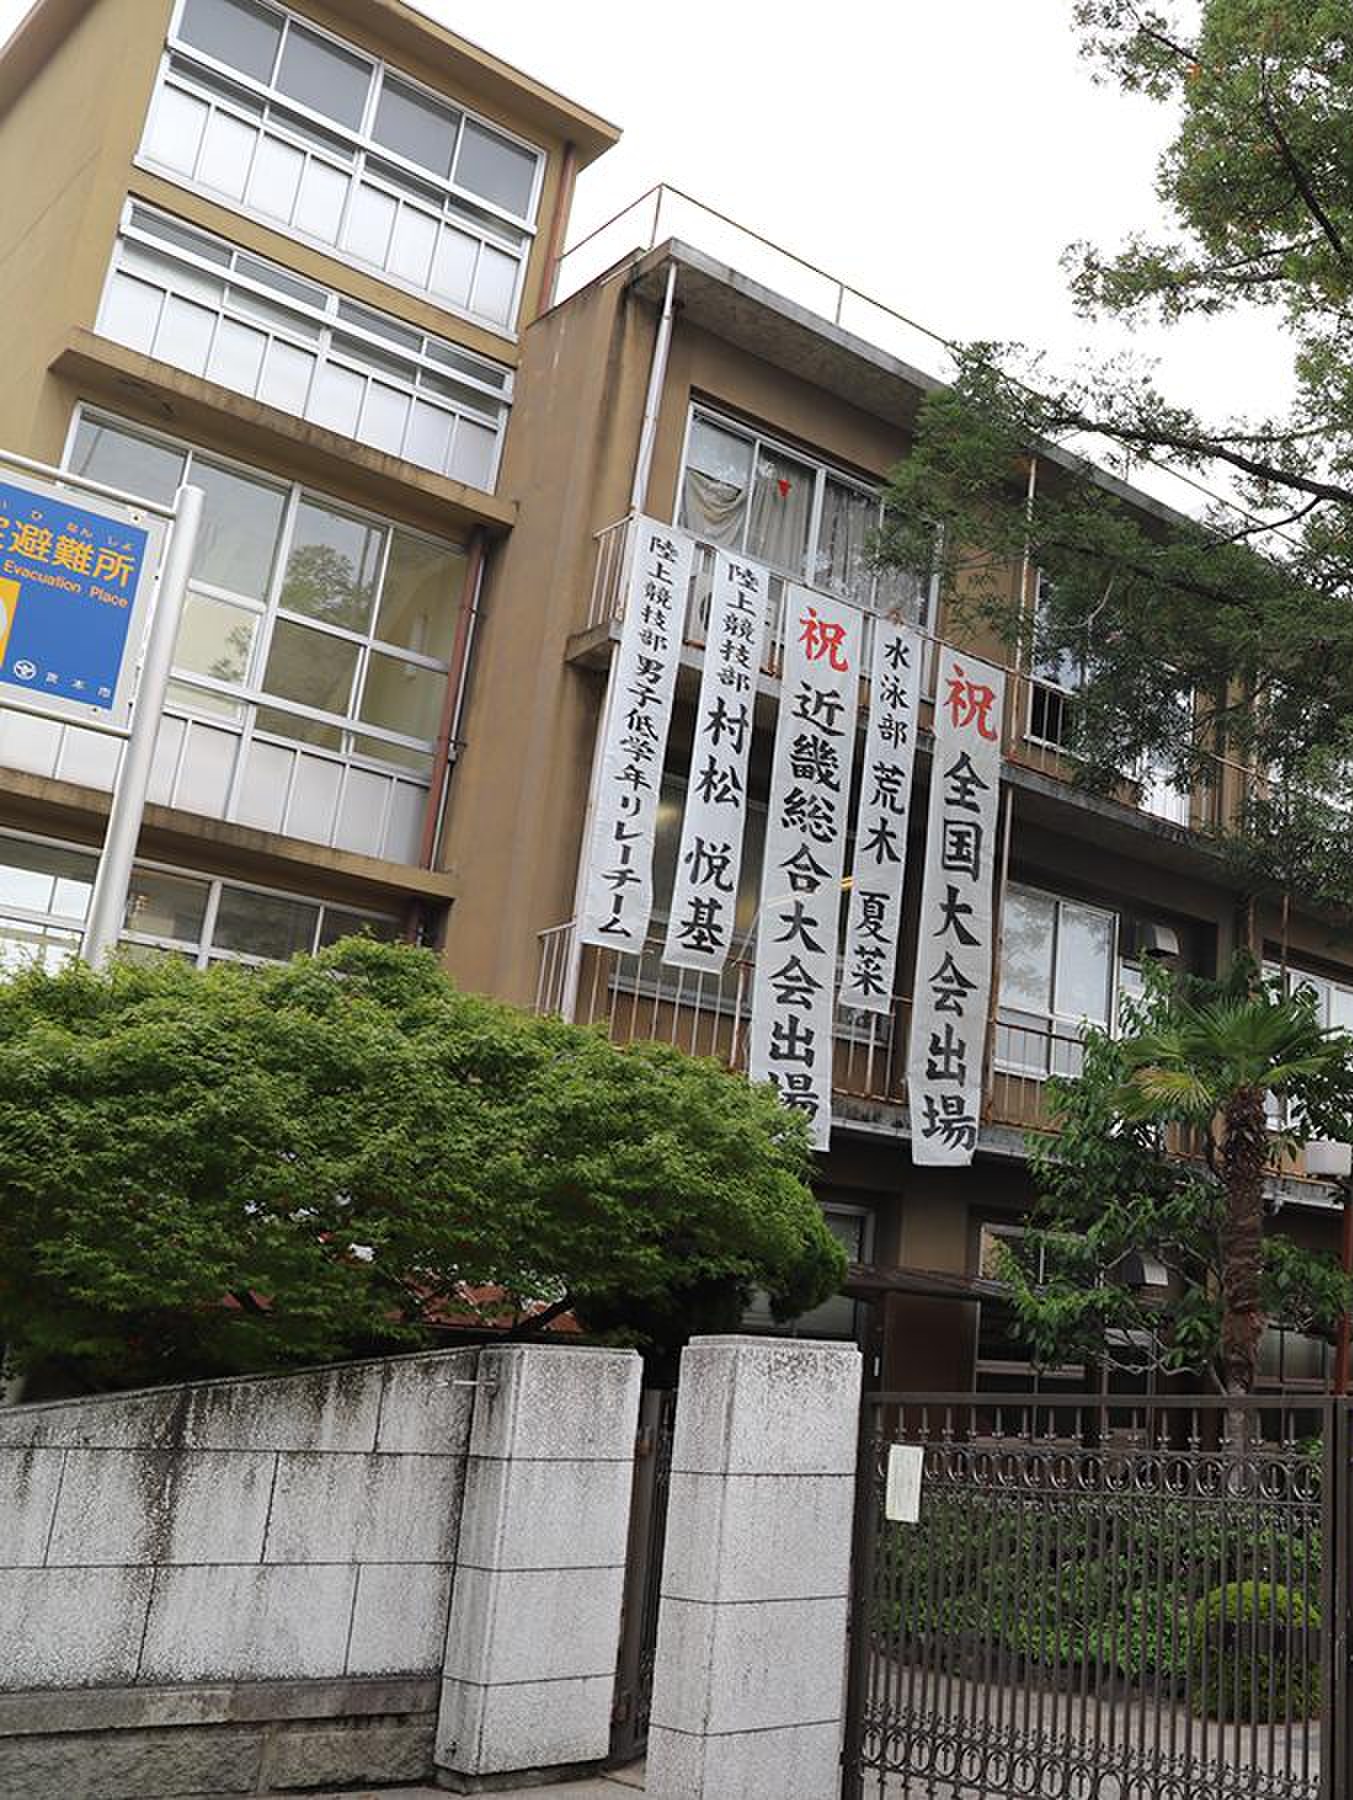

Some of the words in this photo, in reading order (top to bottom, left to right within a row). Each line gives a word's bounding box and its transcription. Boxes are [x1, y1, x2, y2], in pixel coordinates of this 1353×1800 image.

[2, 559, 81, 593] Evacuation
[89, 585, 129, 608] Place
[799, 607, 849, 673] 祝
[877, 636, 912, 750] 水泳部
[694, 696, 750, 808] 村松
[943, 662, 999, 742] 祝
[862, 760, 906, 865] 荒木
[676, 836, 735, 955] 悦基
[851, 889, 893, 997] 夏菜
[921, 751, 990, 1151] 全国大会出場
